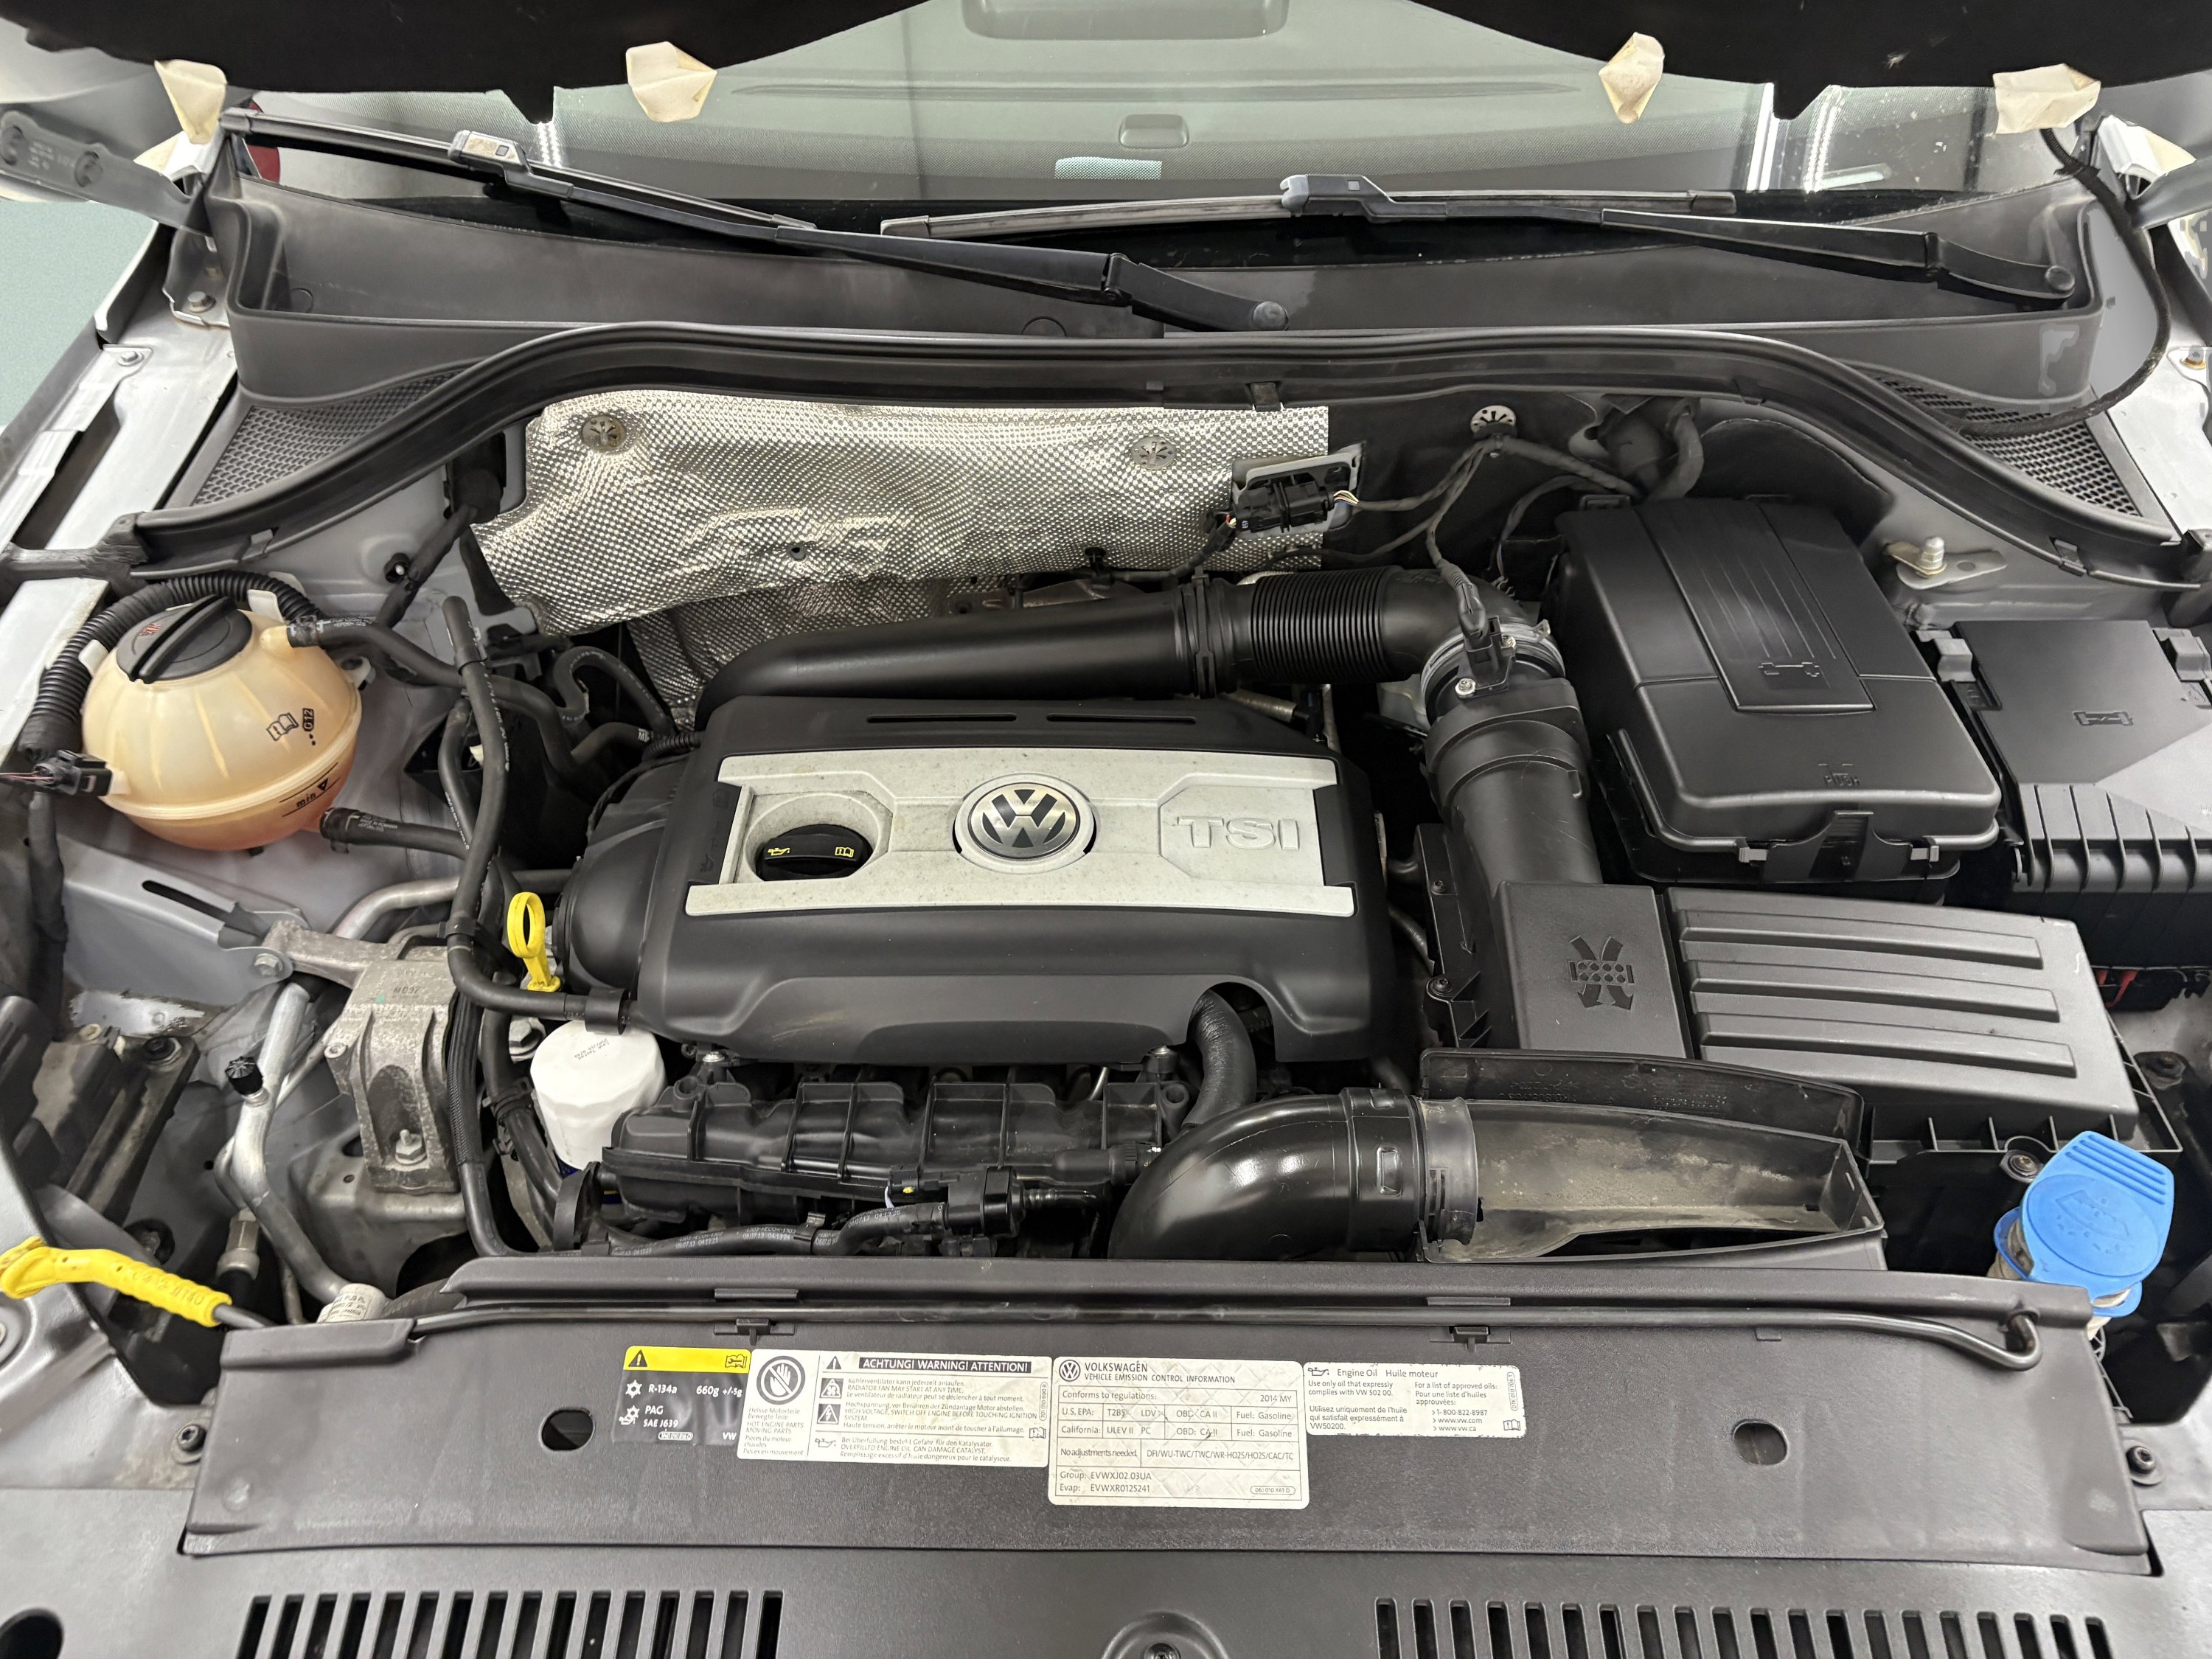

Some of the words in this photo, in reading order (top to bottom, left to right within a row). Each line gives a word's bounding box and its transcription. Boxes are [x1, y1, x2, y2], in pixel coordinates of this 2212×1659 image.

[303, 709, 313, 729] G12
[296, 792, 317, 808] min
[1178, 816, 1300, 850] TSI
[863, 1358, 914, 1369] ACHTUNG!
[917, 1360, 969, 1371] WARNING!
[970, 1362, 1028, 1372] ATTENTION!
[1084, 1363, 1148, 1372] VOLKSWAGEN
[1338, 1368, 1364, 1378] Engine
[1385, 1369, 1407, 1377] Huile
[1084, 1373, 1112, 1381] VEHICLE
[1186, 1375, 1236, 1383] INFORMATION
[1322, 1380, 1336, 1388] only
[1363, 1381, 1393, 1389] expressly
[1452, 1382, 1483, 1391] approved
[648, 1384, 678, 1394] R-134a
[696, 1385, 720, 1397] 660g
[723, 1388, 742, 1398] +/-5g
[1308, 1388, 1338, 1397] complies
[1062, 1391, 1099, 1399] Conforms
[1111, 1392, 1157, 1401] regulations:
[644, 1405, 664, 1414] PAG
[1062, 1408, 1077, 1416] U.S.
[1077, 1408, 1094, 1416] EPA:
[1141, 1409, 1156, 1417] LDV
[1176, 1410, 1197, 1418] OBD
[1200, 1410, 1211, 1418] CA
[1335, 1406, 1376, 1415] uniquement
[1236, 1411, 1255, 1419] Fuel:
[1258, 1412, 1292, 1420] Gasoline
[1349, 1415, 1398, 1424] expressément
[643, 1419, 658, 1427] SAE
[658, 1419, 679, 1428] J639
[992, 1426, 1025, 1434] l'allumage.
[1061, 1425, 1101, 1434] California:
[1107, 1427, 1127, 1435] ULEV
[1176, 1427, 1197, 1436] OBD:
[1200, 1428, 1211, 1436] CA
[1237, 1429, 1255, 1437] Fuel:
[1259, 1429, 1293, 1438] Gasoline
[723, 1432, 737, 1441] VW
[1060, 1448, 1071, 1456] No
[1071, 1448, 1112, 1458] adjustments
[1060, 1471, 1087, 1481] Group:
[1060, 1484, 1080, 1493] Evap:
